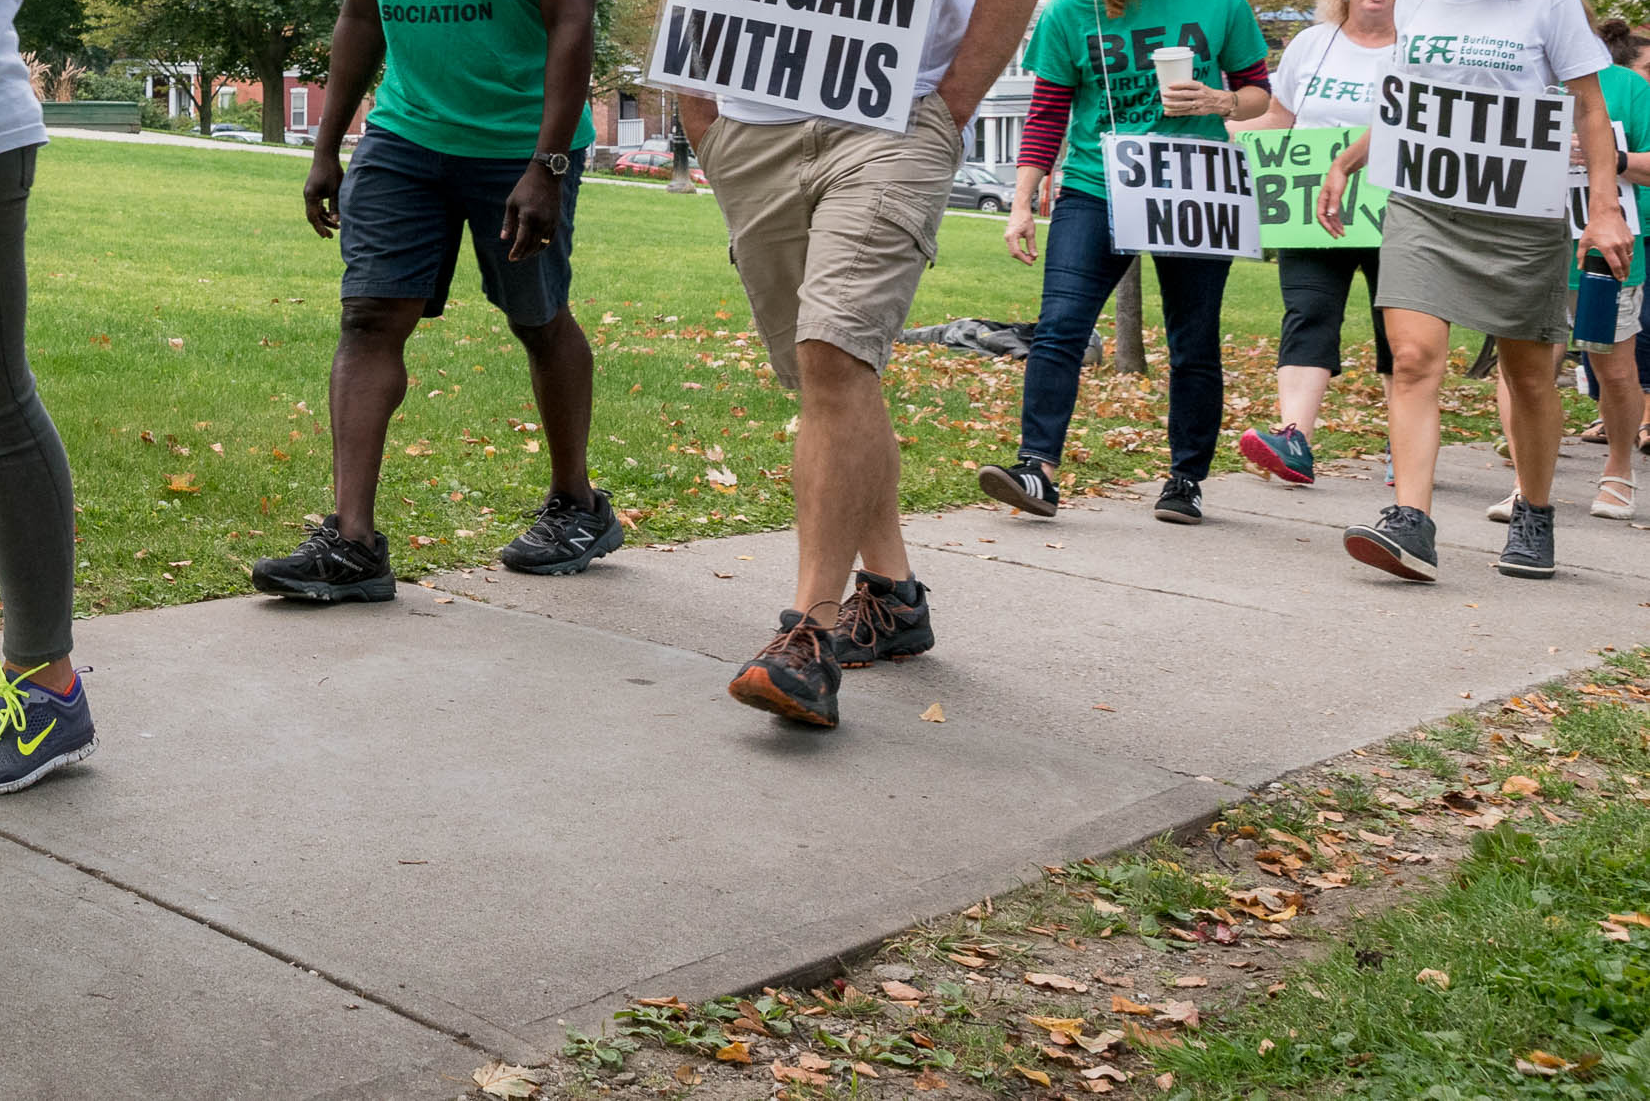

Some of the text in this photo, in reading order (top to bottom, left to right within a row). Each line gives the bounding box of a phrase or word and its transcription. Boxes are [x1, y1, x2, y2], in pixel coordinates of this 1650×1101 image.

[382, 2, 493, 23] SOCIATION
[663, 5, 898, 119] WITH US
[1086, 22, 1211, 75] BEA
[1458, 56, 1523, 73] Association
[1459, 45, 1516, 60] Education
[1462, 35, 1524, 51] Burlington
[1380, 74, 1563, 152] SETTLE
[1116, 140, 1252, 196] SETTLE
[1395, 138, 1527, 209] NOW
[1146, 198, 1240, 251] NOW
